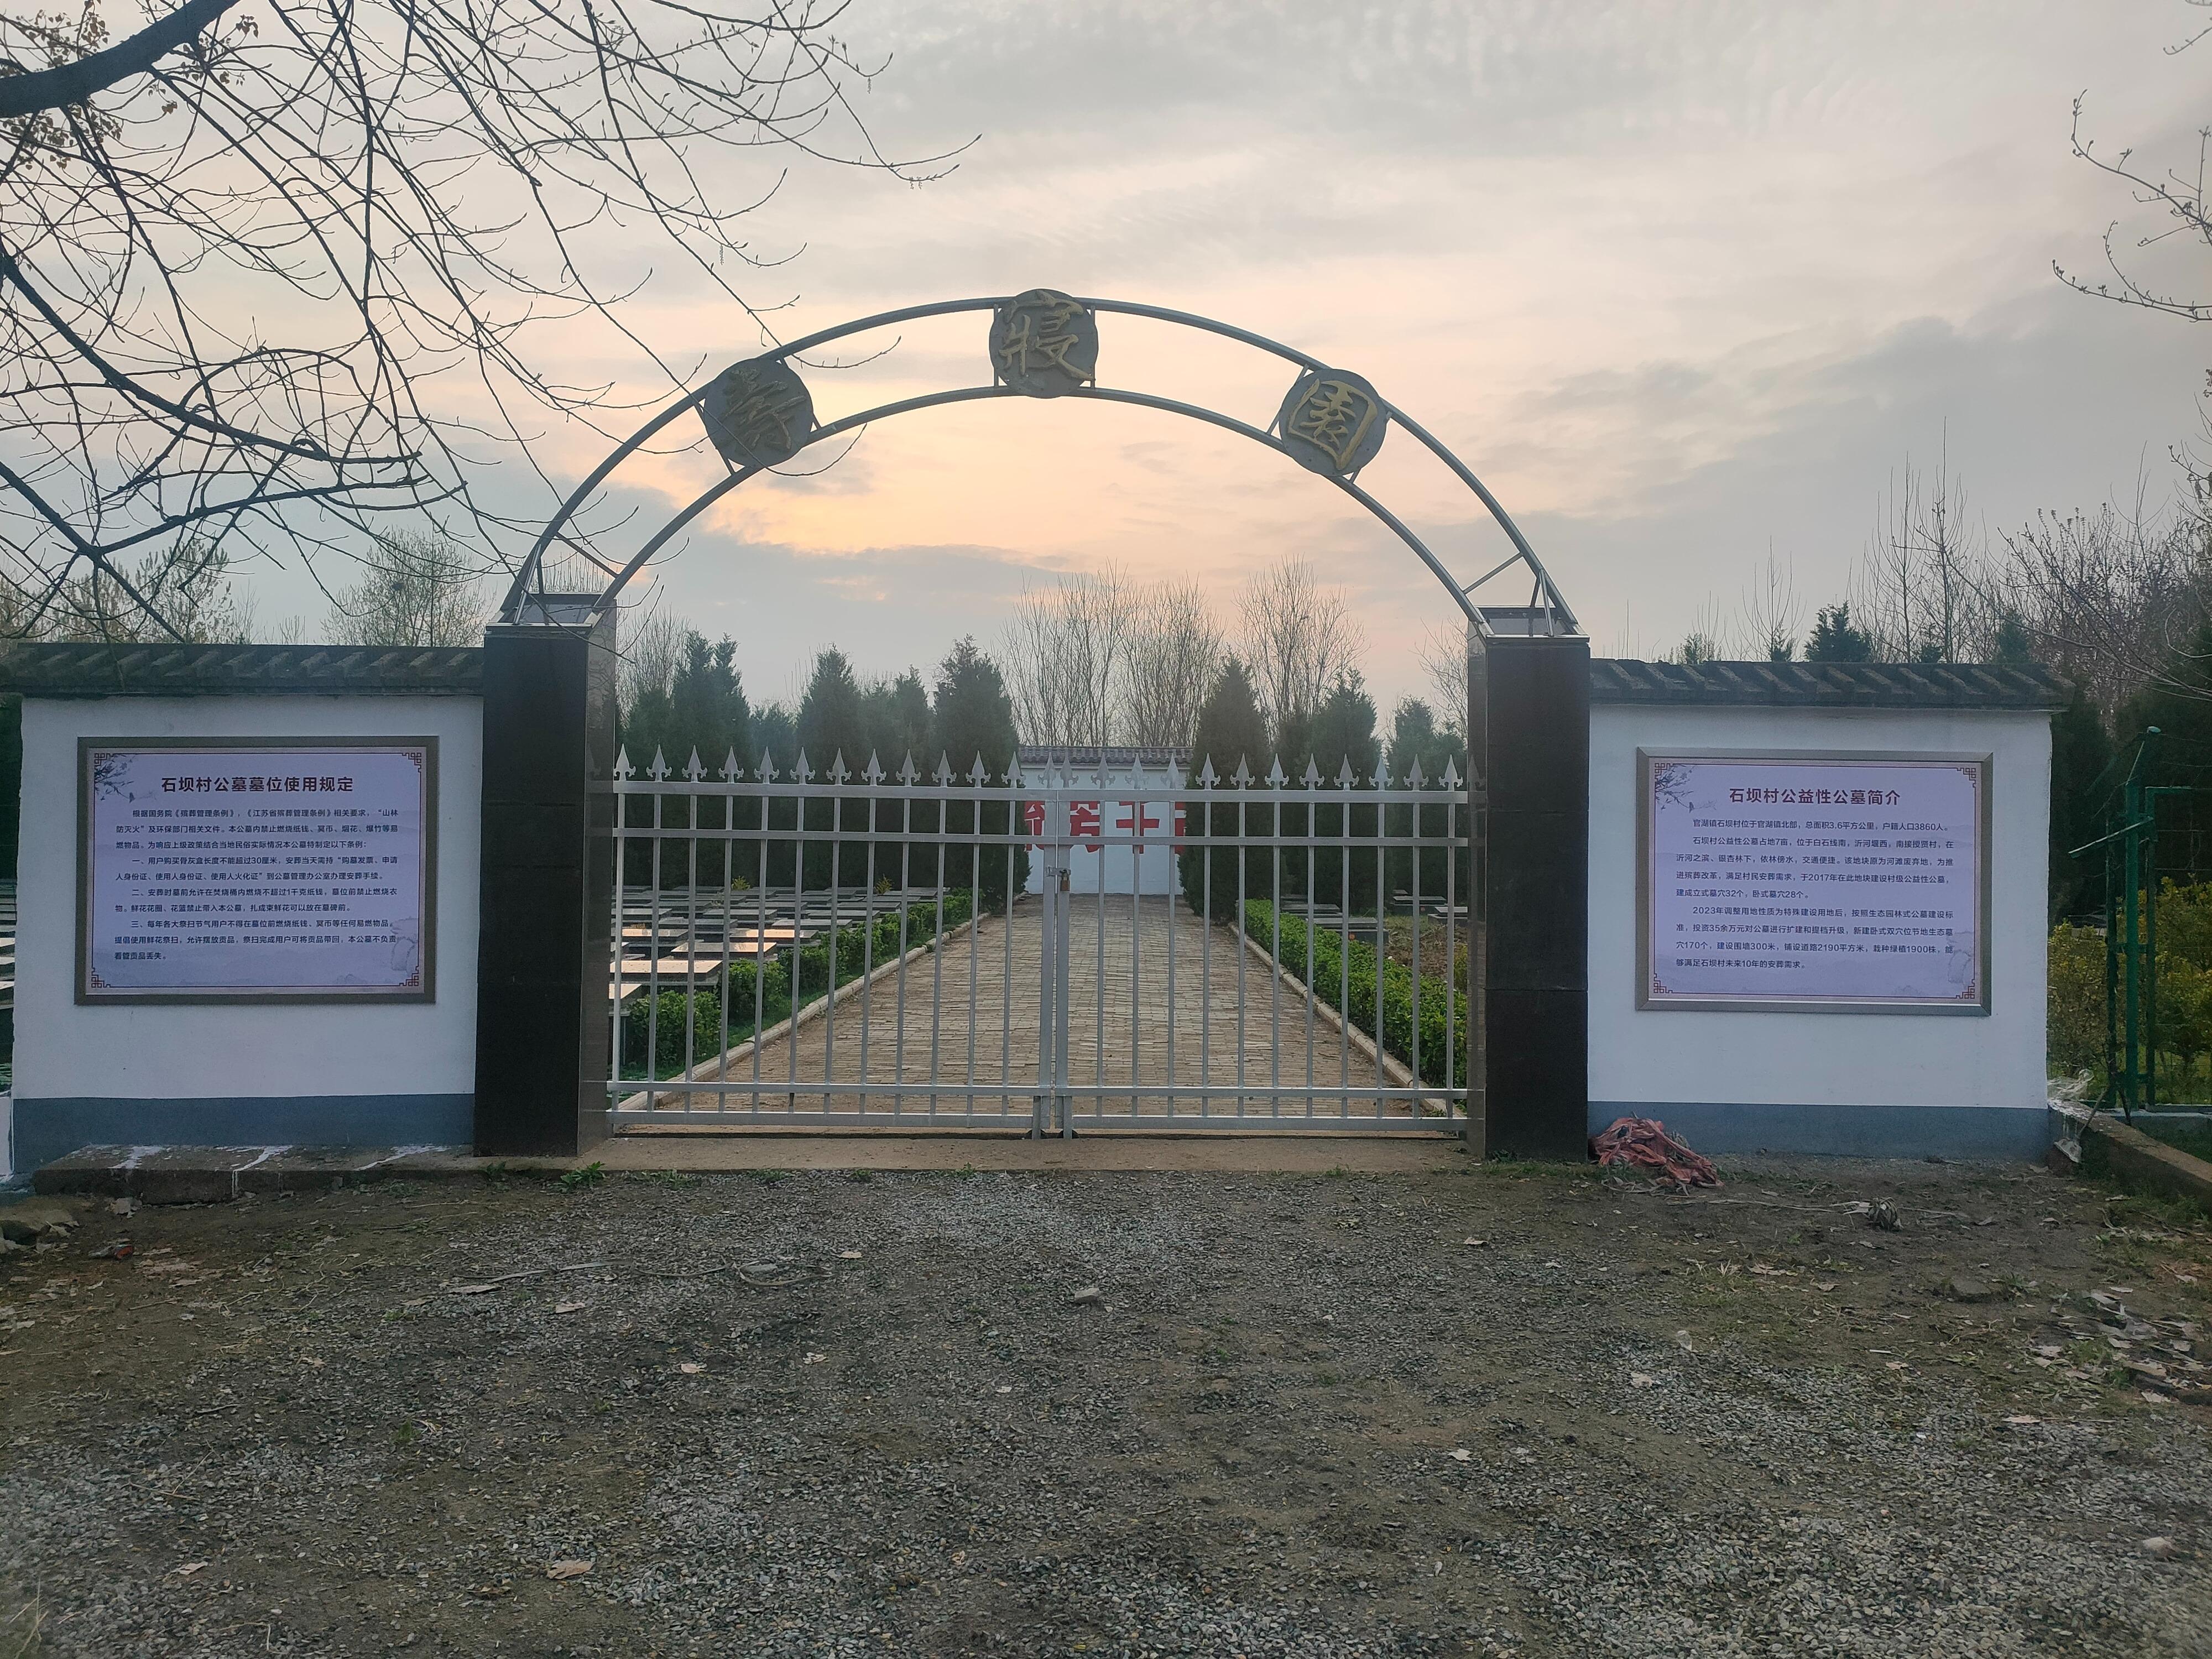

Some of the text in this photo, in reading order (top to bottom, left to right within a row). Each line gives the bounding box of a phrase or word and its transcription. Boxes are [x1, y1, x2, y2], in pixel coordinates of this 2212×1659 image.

[161, 776, 353, 792] 石坝村公墓墓位使用规定
[1729, 787, 1901, 806] 石坝村公益性公墓简介
[114, 952, 167, 960] 看管贡品丢失。
